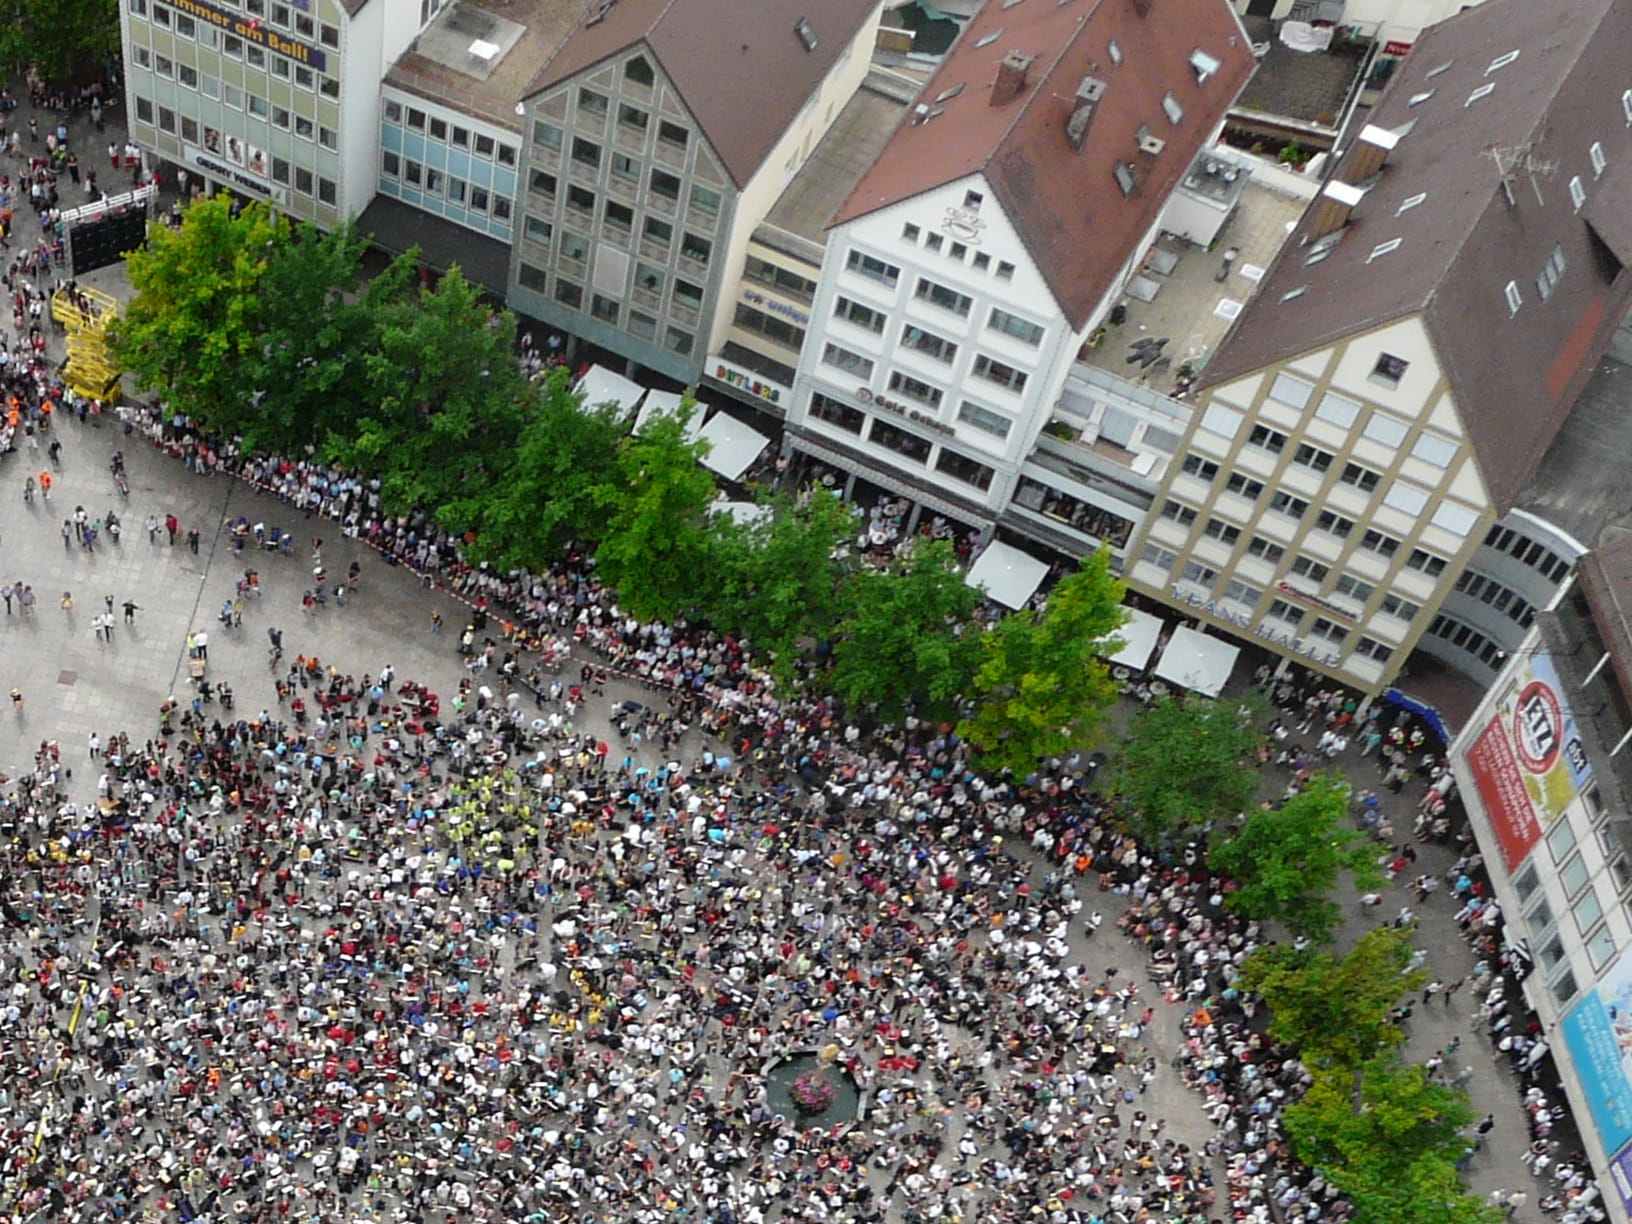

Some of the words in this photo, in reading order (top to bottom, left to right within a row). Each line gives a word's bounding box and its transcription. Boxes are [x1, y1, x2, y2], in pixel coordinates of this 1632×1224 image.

[235, 22, 263, 43] am
[268, 32, 308, 62] Ball!
[1254, 623, 1342, 668] HALLE
[1510, 951, 1525, 981] abt
